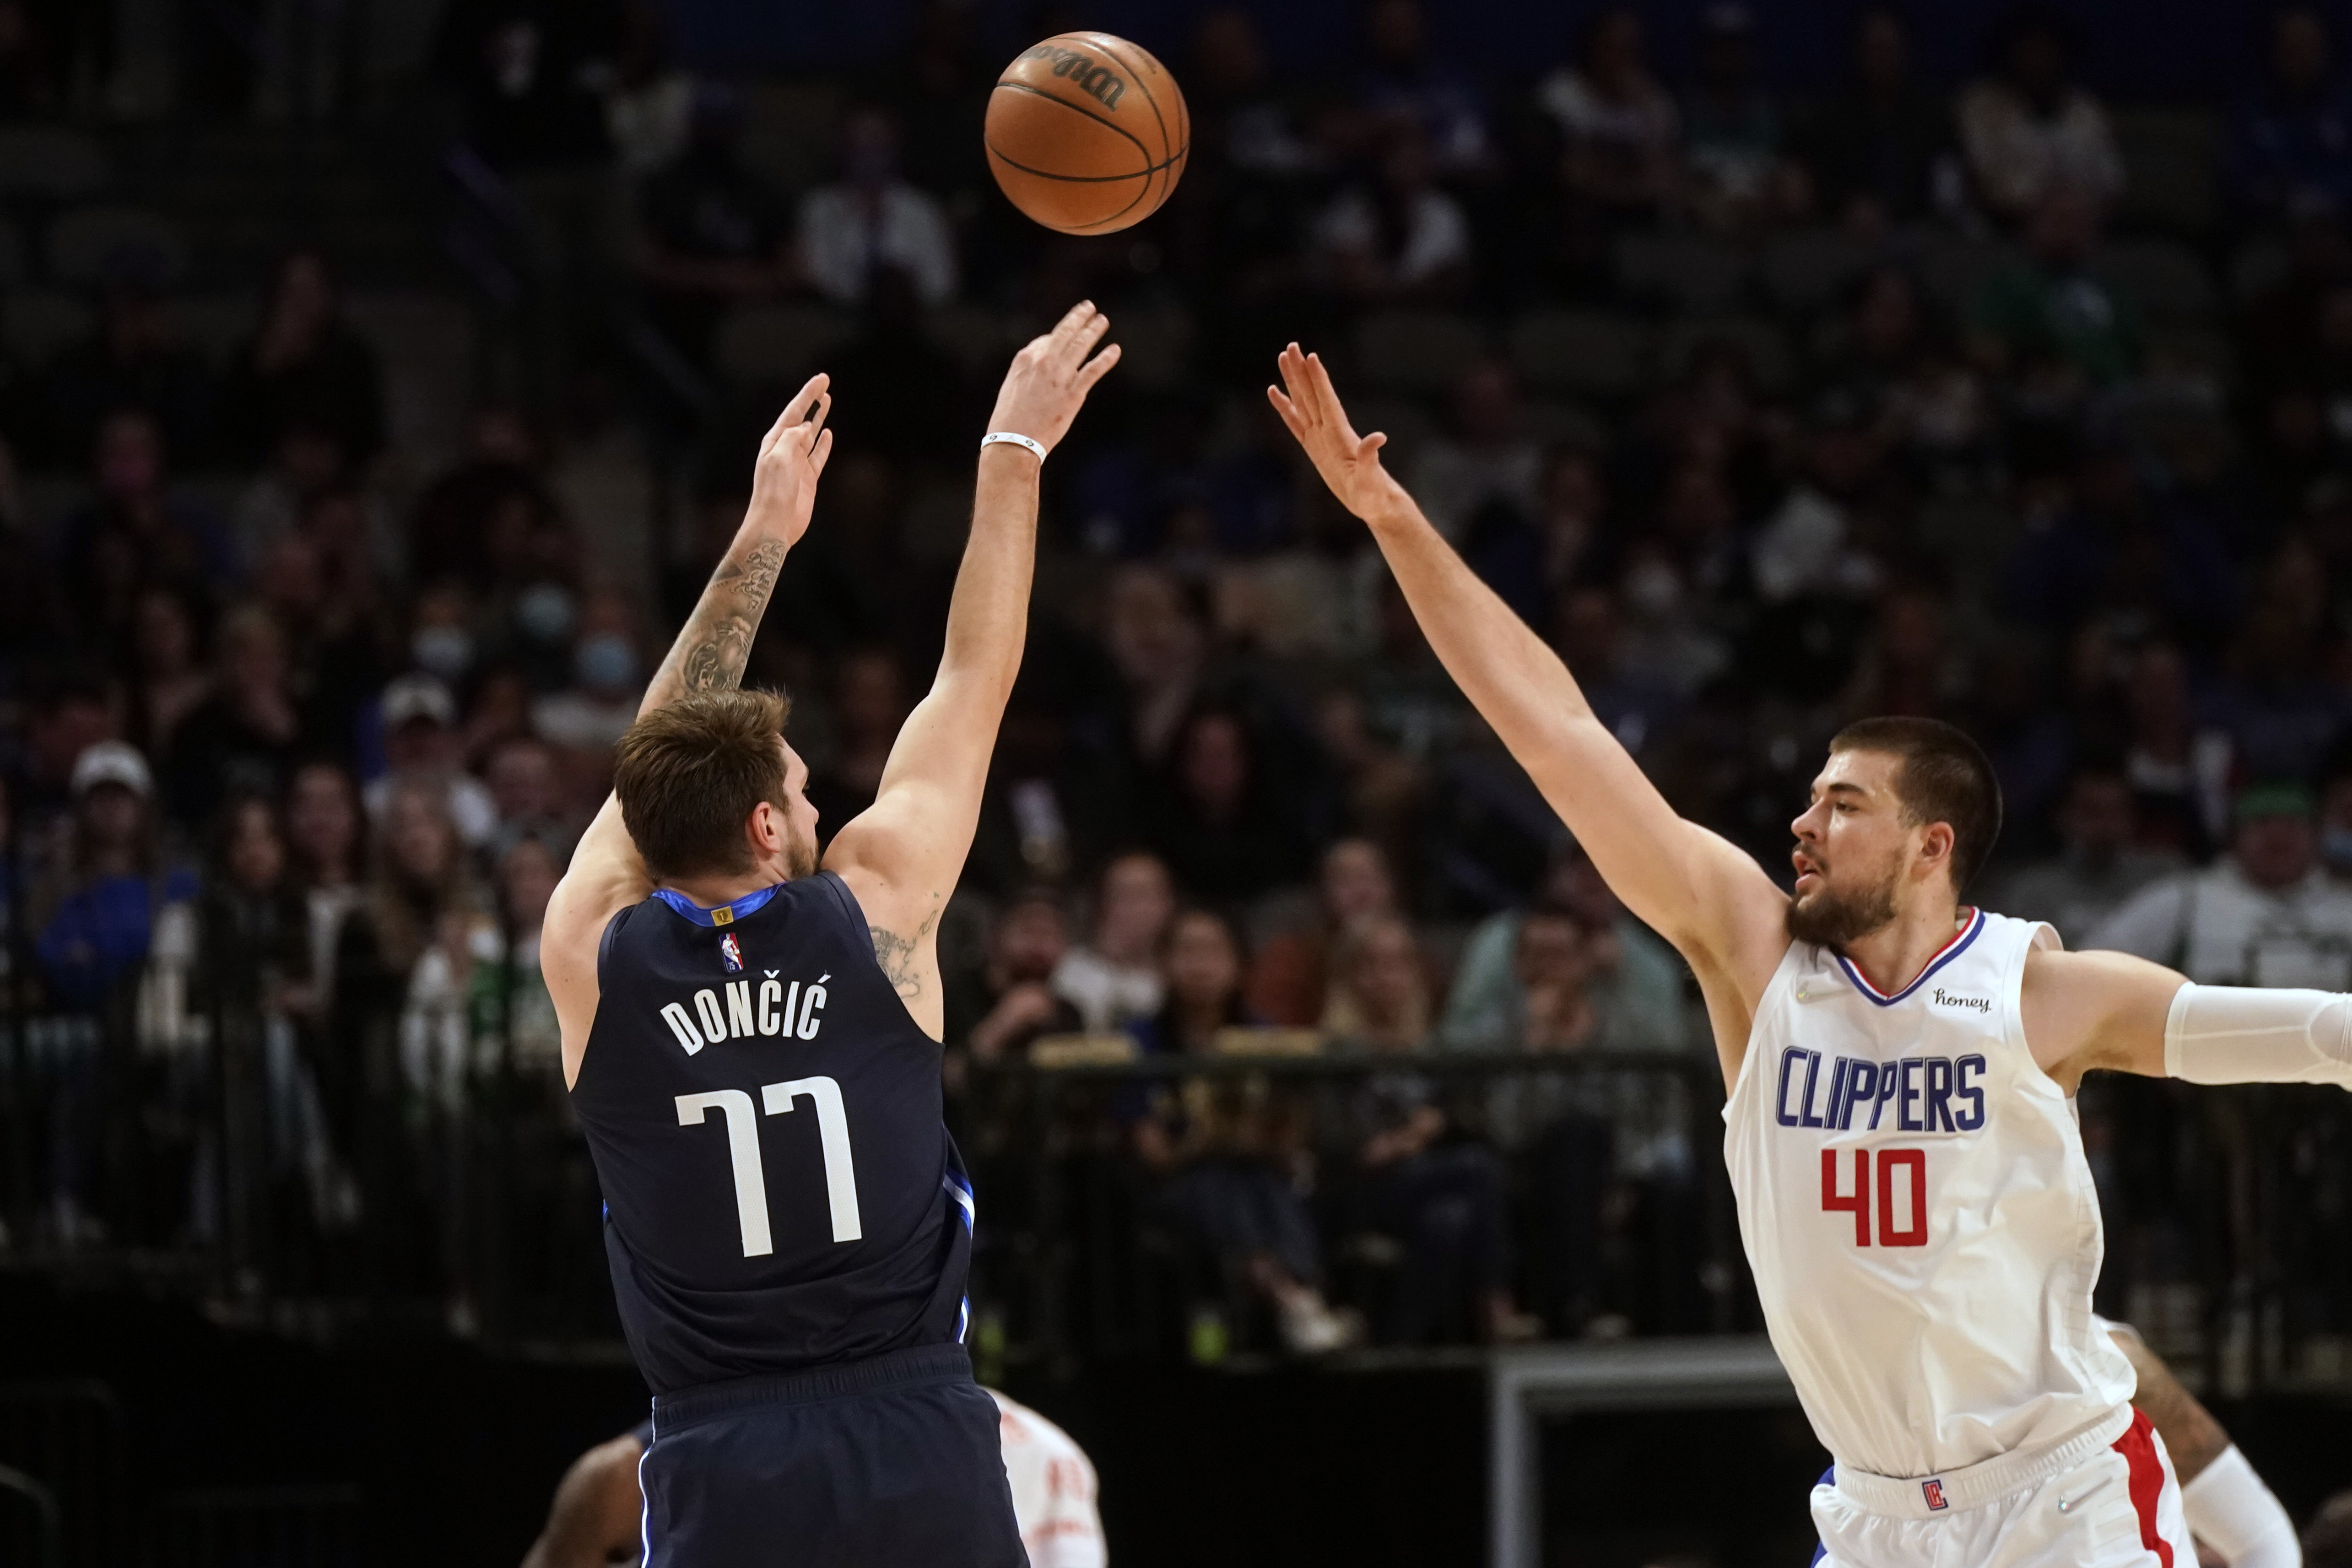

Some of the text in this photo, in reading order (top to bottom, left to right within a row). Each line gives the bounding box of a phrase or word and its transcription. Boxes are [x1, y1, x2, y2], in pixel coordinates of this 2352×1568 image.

[660, 969, 832, 1056] DONČIĆ
[1933, 988, 1991, 1014] honey
[1776, 1045, 1986, 1132] CLIPPERS
[675, 1076, 862, 1257] 77
[1821, 1149, 1928, 1247] 40
